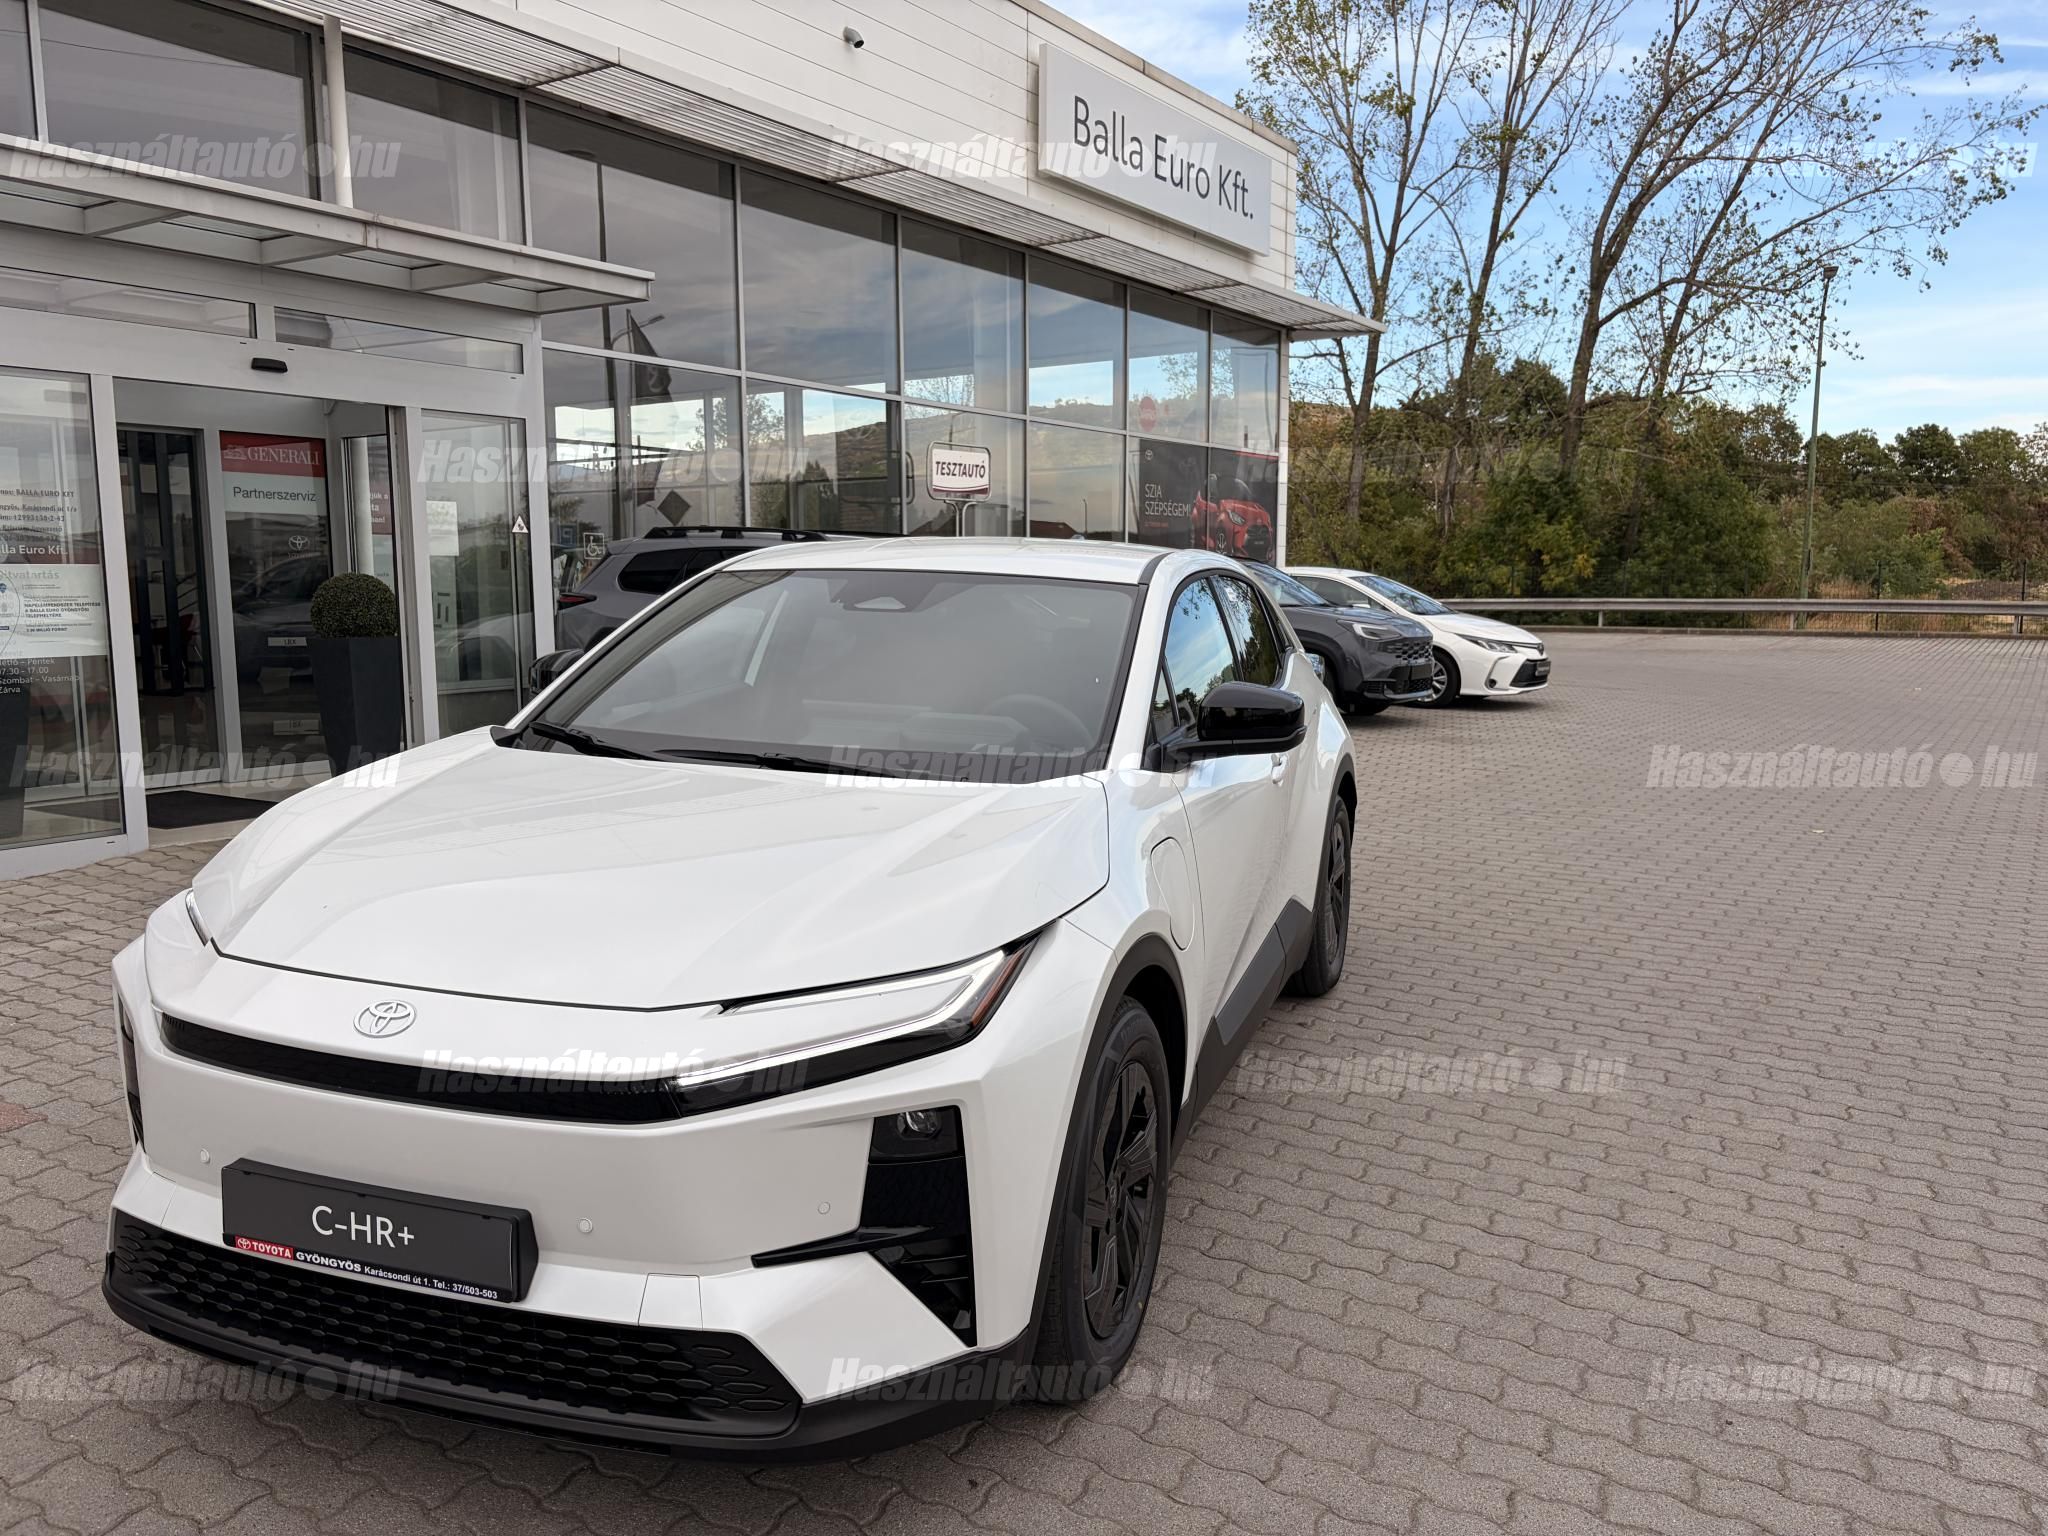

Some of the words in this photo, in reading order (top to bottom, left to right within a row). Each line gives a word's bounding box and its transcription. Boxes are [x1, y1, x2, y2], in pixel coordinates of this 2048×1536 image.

[1074, 95, 1144, 172] Balla
[1155, 134, 1211, 199] Euro
[1218, 164, 1254, 219] Kft.
[247, 447, 320, 465] GENERALI
[936, 460, 986, 478] TESZTAUTÓ
[233, 486, 317, 502] Partnerszerviz
[1145, 483, 1162, 498] SZIA
[19, 545, 45, 554] Euro
[312, 1205, 415, 1248] C-HR+
[252, 1241, 291, 1258] TOYOTA
[296, 1251, 361, 1272] GYÖNGYÖS
[364, 1265, 411, 1282] Karácsondi
[413, 1275, 422, 1285] út
[433, 1279, 450, 1290] Tel.:
[453, 1283, 498, 1299] 37/503-503
